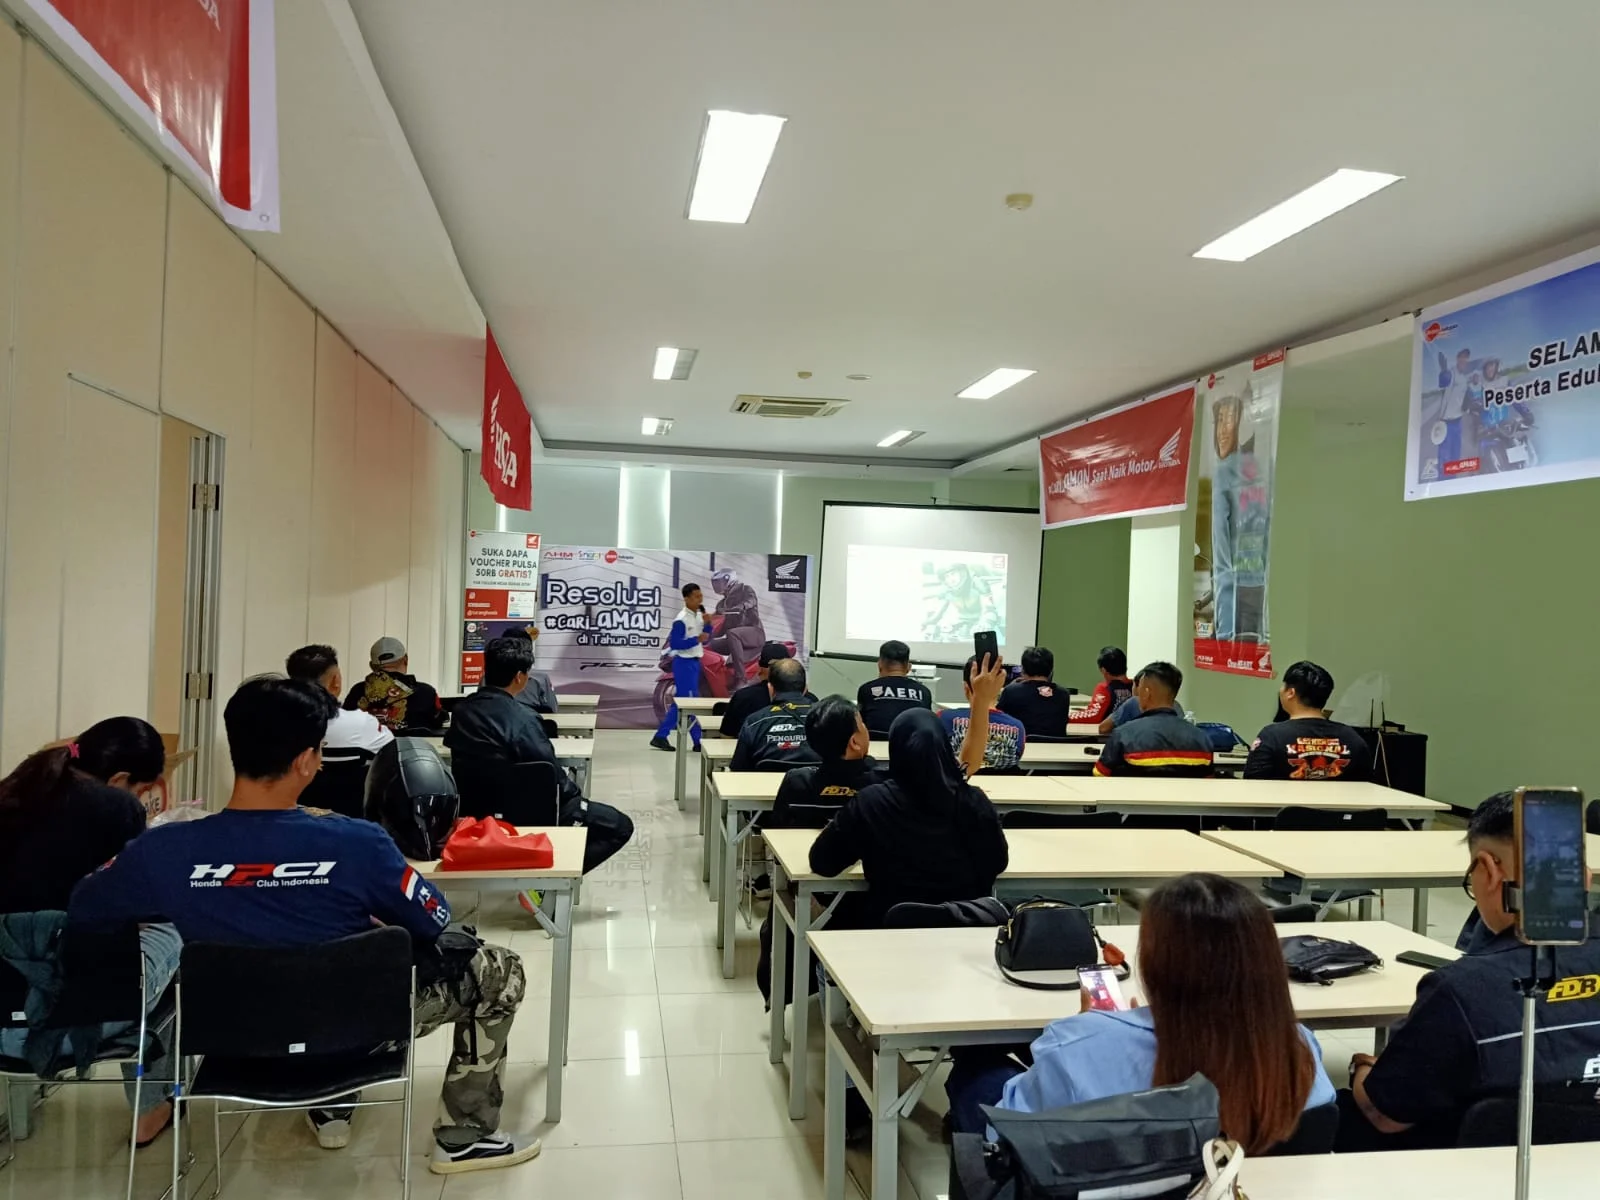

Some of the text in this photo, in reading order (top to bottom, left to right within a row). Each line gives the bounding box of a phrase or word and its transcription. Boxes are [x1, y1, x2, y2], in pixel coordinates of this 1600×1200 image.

[1484, 363, 1600, 408] Peserta Edu
[1092, 468, 1108, 483] Saat
[1109, 463, 1126, 480] Naik
[481, 548, 528, 558] SUKA DAPA
[470, 557, 537, 568] VOUCHER PULSA
[498, 570, 532, 578] GRATIS?
[546, 580, 661, 606] Resolusi
[577, 633, 660, 646] di Tahun Baru
[884, 686, 923, 700] AERI
[766, 734, 807, 743] PENGURU
[190, 861, 337, 881] HPCI
[190, 879, 222, 888] Honda
[256, 878, 279, 888] Club
[281, 877, 329, 887] Indonesia
[1546, 974, 1600, 1003] FDR
